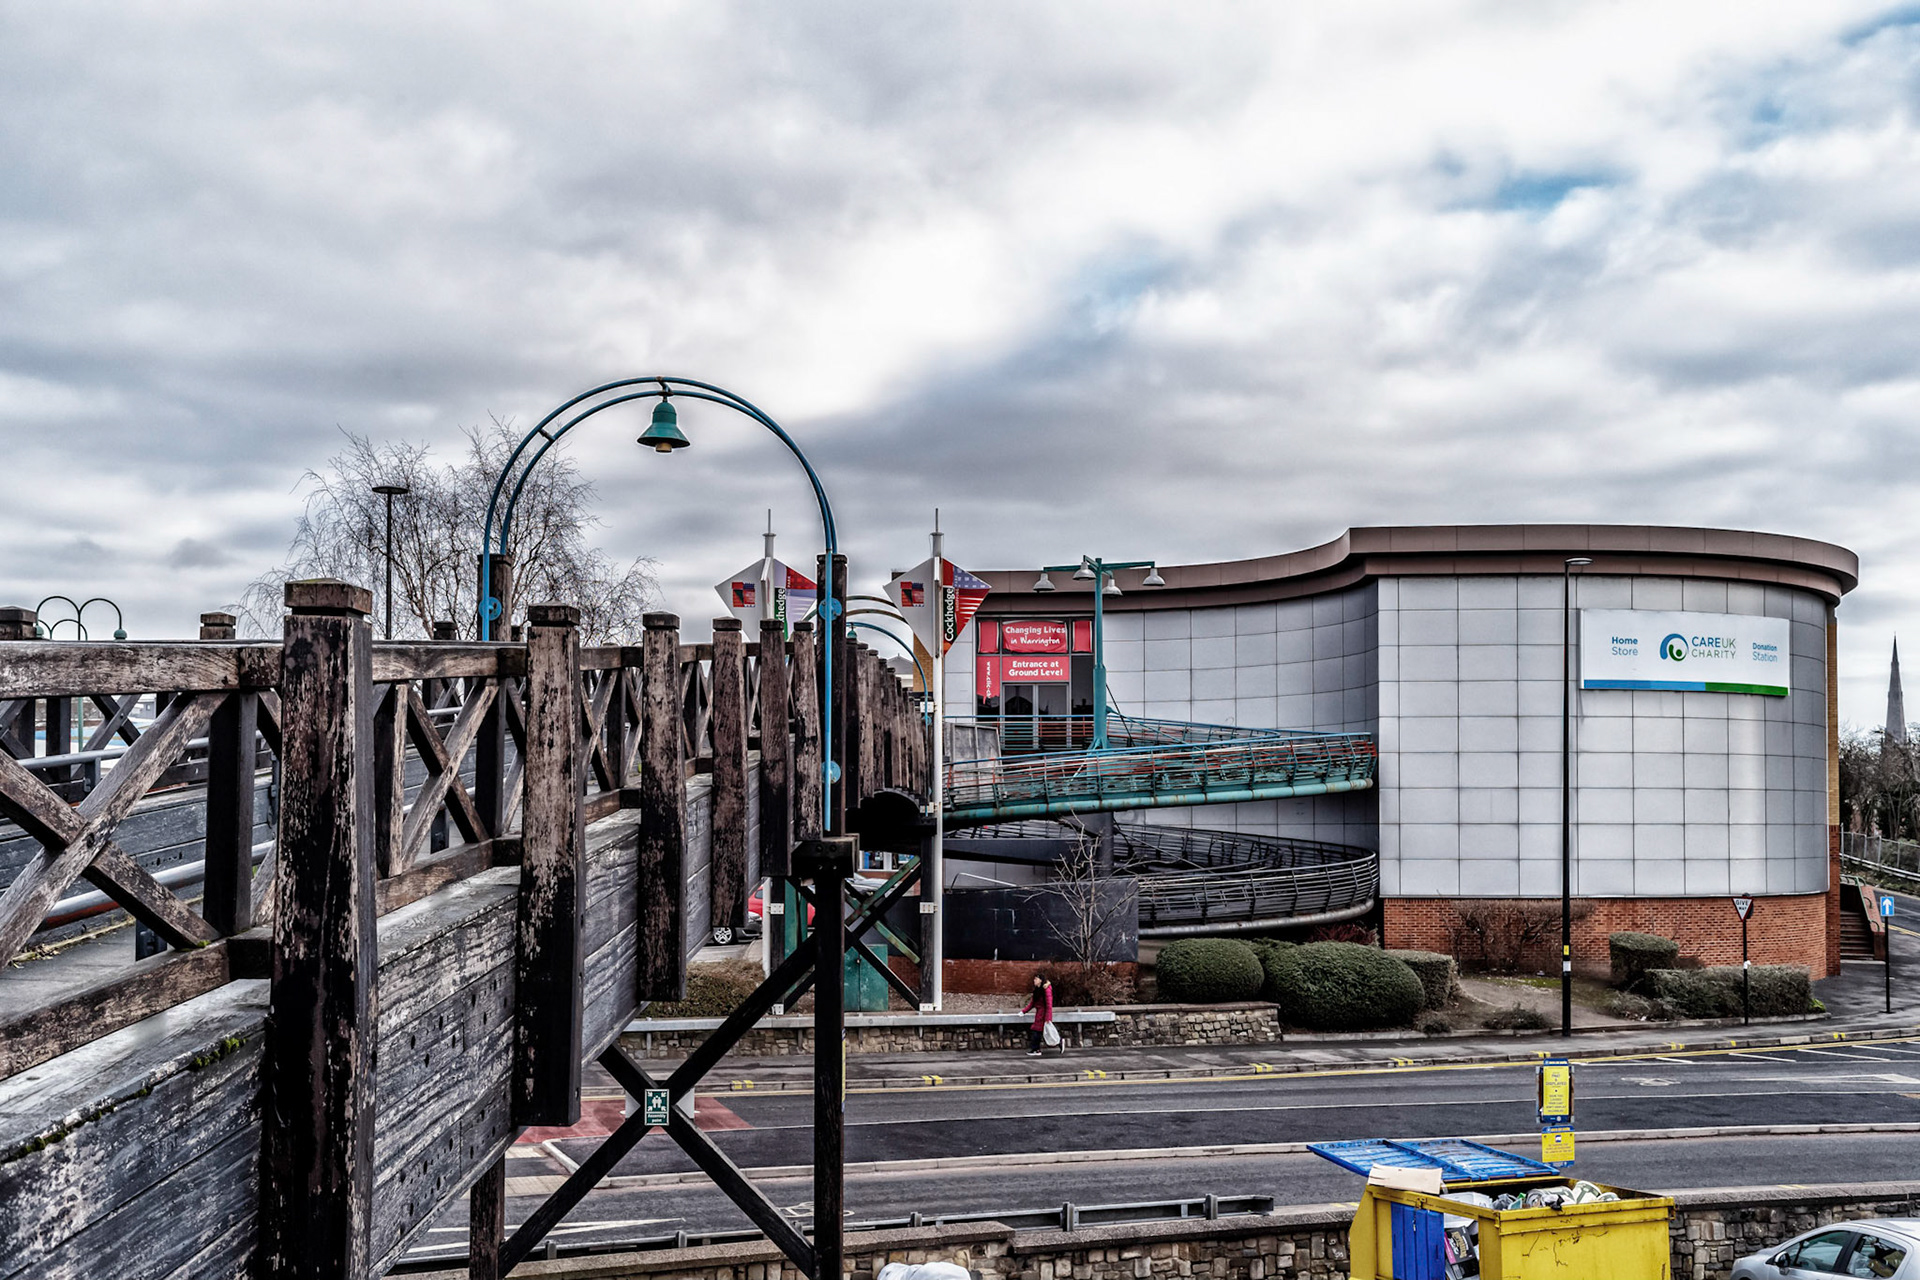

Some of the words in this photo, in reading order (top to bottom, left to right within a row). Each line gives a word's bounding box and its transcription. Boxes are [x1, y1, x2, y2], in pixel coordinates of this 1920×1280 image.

[945, 588, 955, 642] Cockhedge
[1005, 626, 1042, 635] Changing
[1043, 626, 1066, 634] Lives
[1020, 636, 1061, 646] Warrington
[1611, 636, 1639, 645] Home
[1611, 646, 1639, 656] Store
[1752, 642, 1778, 652] Donation
[1691, 649, 1737, 660] CHARITY
[1752, 651, 1778, 663] Station
[1012, 660, 1048, 668] Entrance
[1050, 660, 1060, 668] at
[1008, 669, 1039, 677] Ground
[1040, 669, 1063, 677] Level
